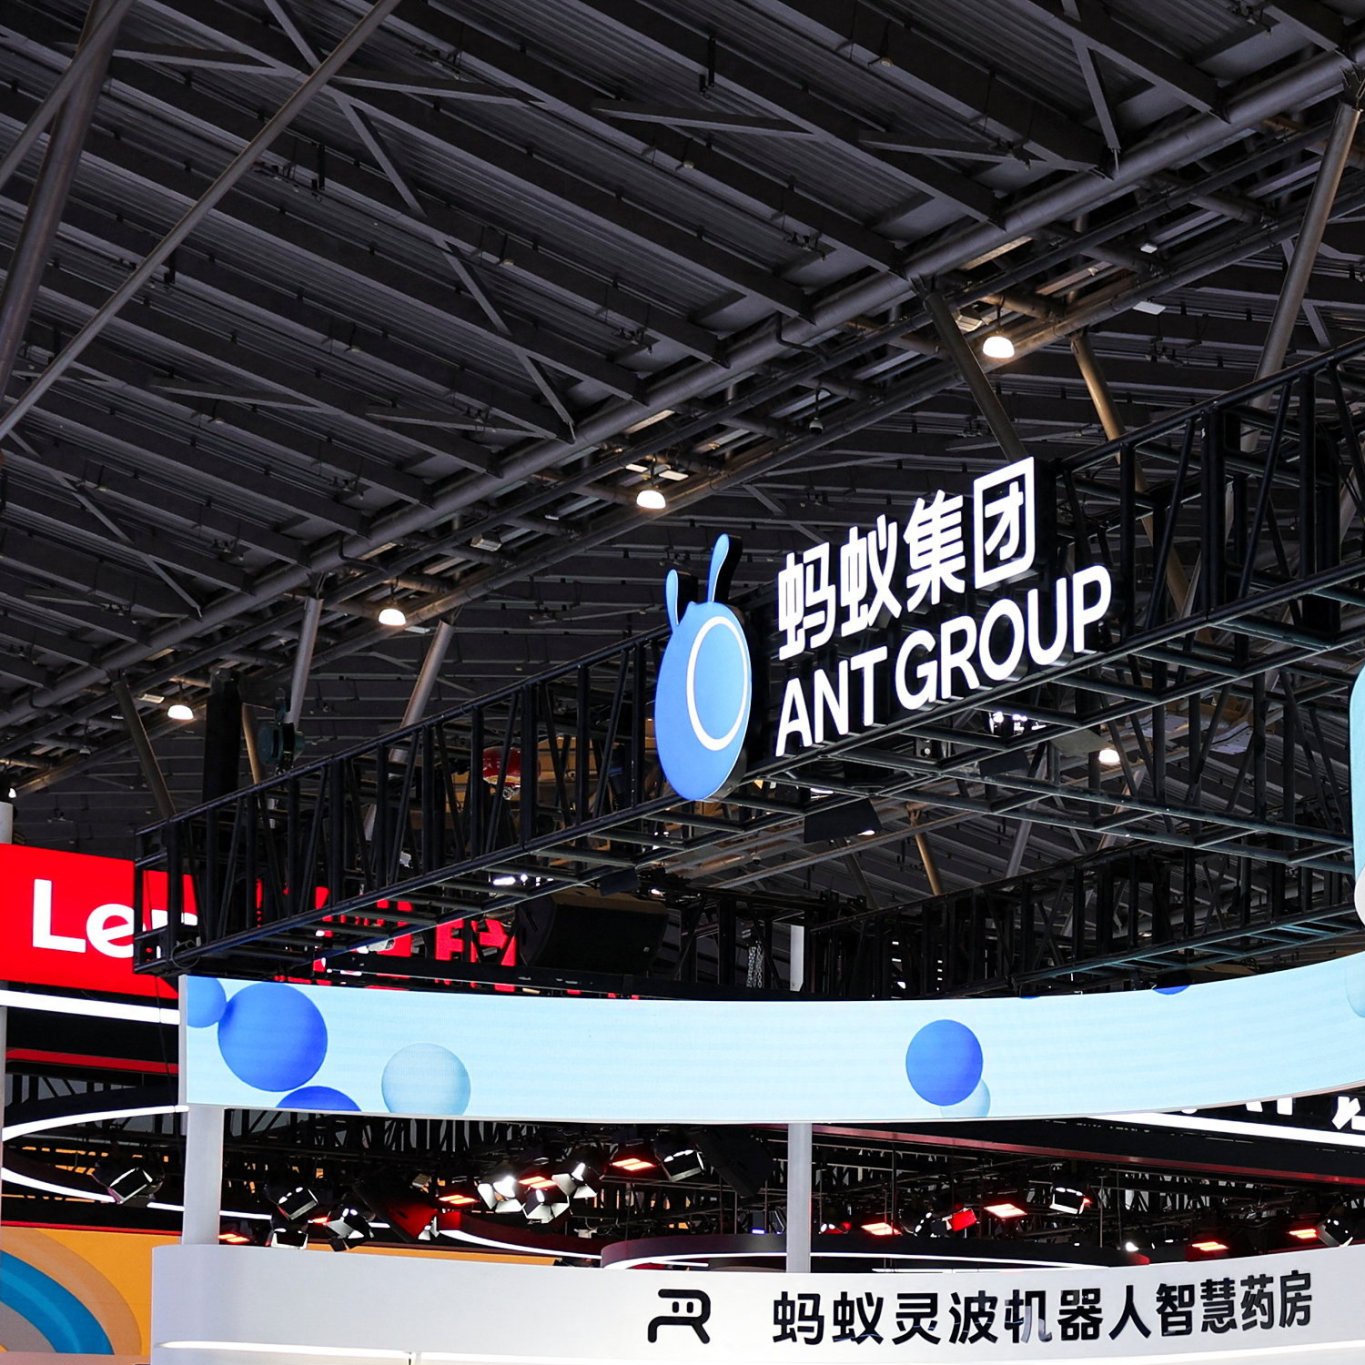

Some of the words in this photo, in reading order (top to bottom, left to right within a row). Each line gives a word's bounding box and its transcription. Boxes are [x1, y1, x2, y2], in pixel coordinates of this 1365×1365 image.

[778, 456, 1035, 661] 蚂蚁集团
[775, 646, 888, 757] ANT
[895, 565, 1112, 711] GROUP
[772, 1270, 1313, 1345] 蚂蚁灵波机器人智慧药房
